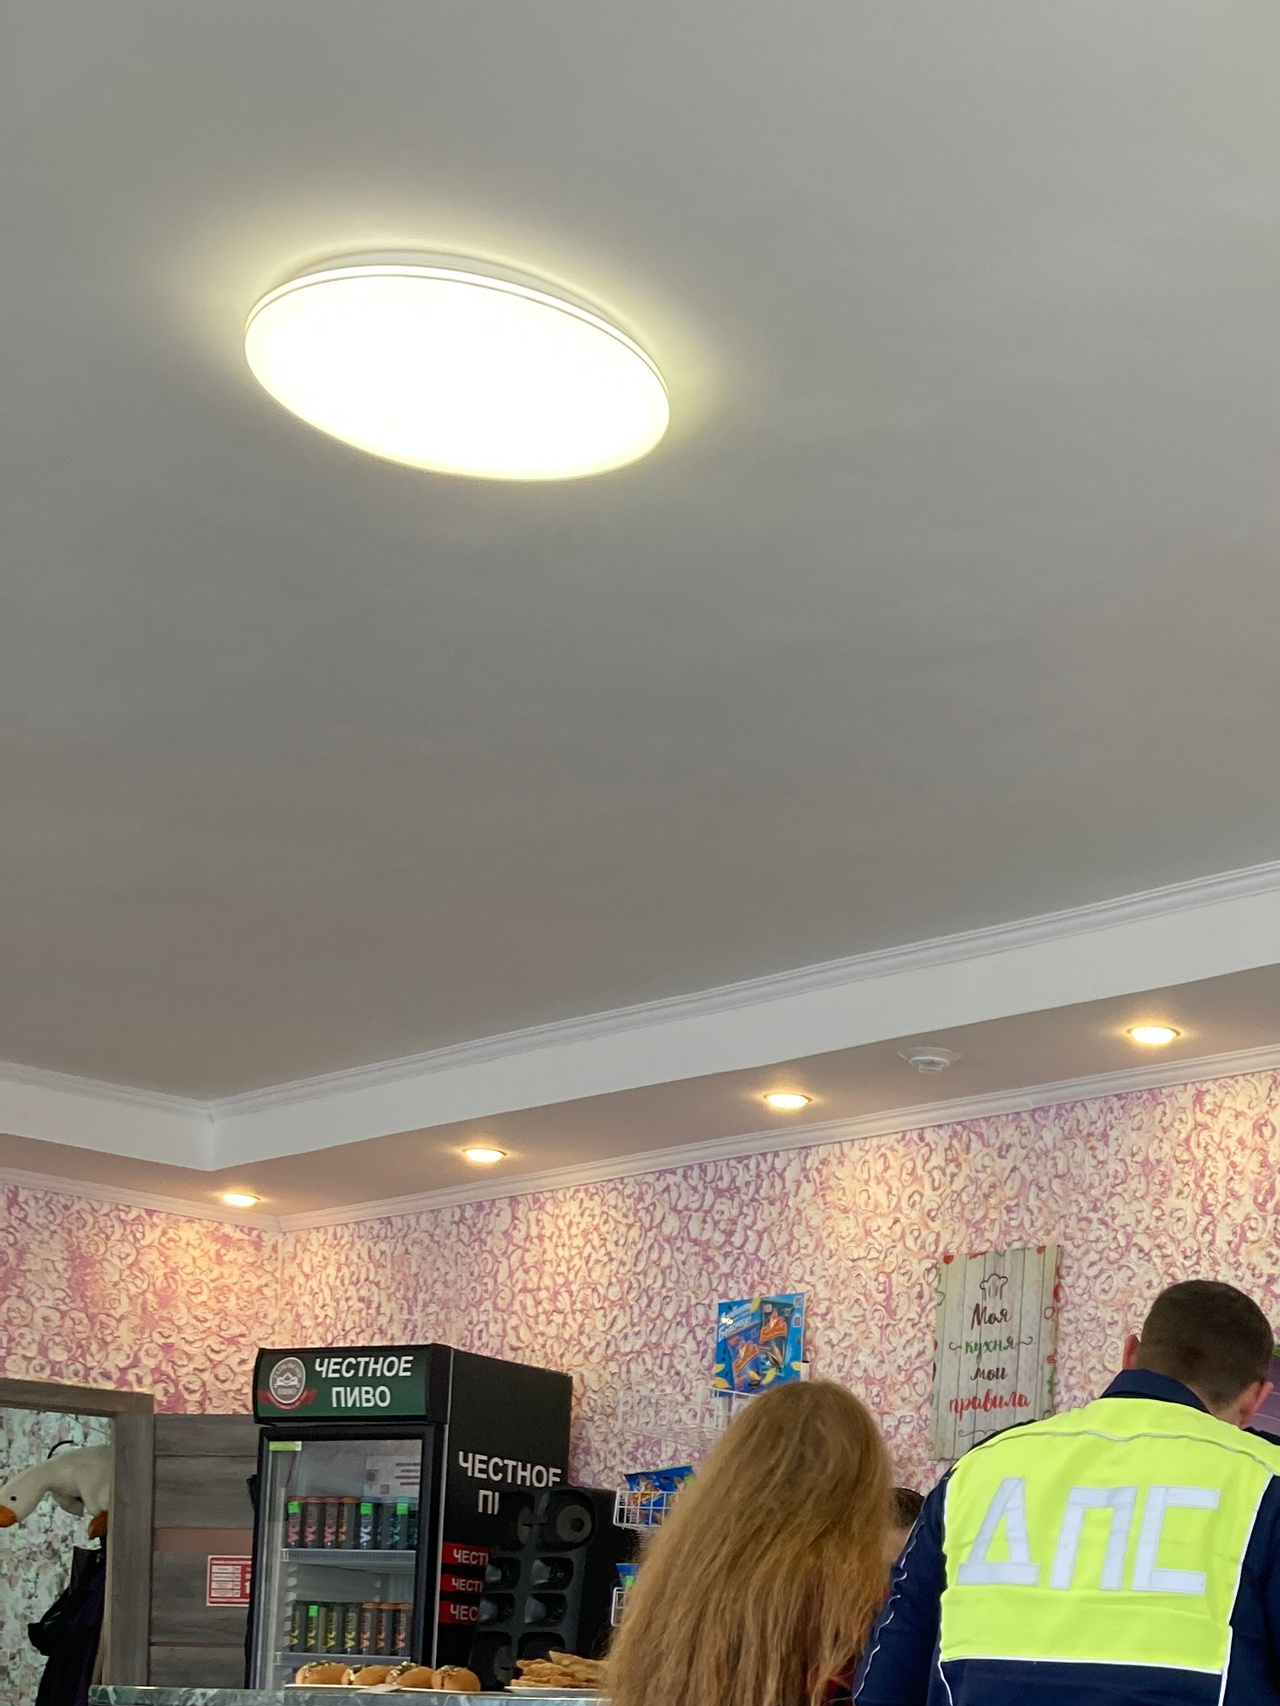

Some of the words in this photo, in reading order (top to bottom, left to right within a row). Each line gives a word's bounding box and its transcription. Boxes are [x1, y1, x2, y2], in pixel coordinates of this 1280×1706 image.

[970, 1303, 1012, 1330] Моя
[965, 1336, 1016, 1364] кухня
[314, 1355, 414, 1378] ЧЕСТНОЕ
[970, 1367, 1008, 1381] мои
[331, 1385, 391, 1408] ПИВО
[949, 1388, 1031, 1422] правила
[956, 1476, 1220, 1595] ДПС
